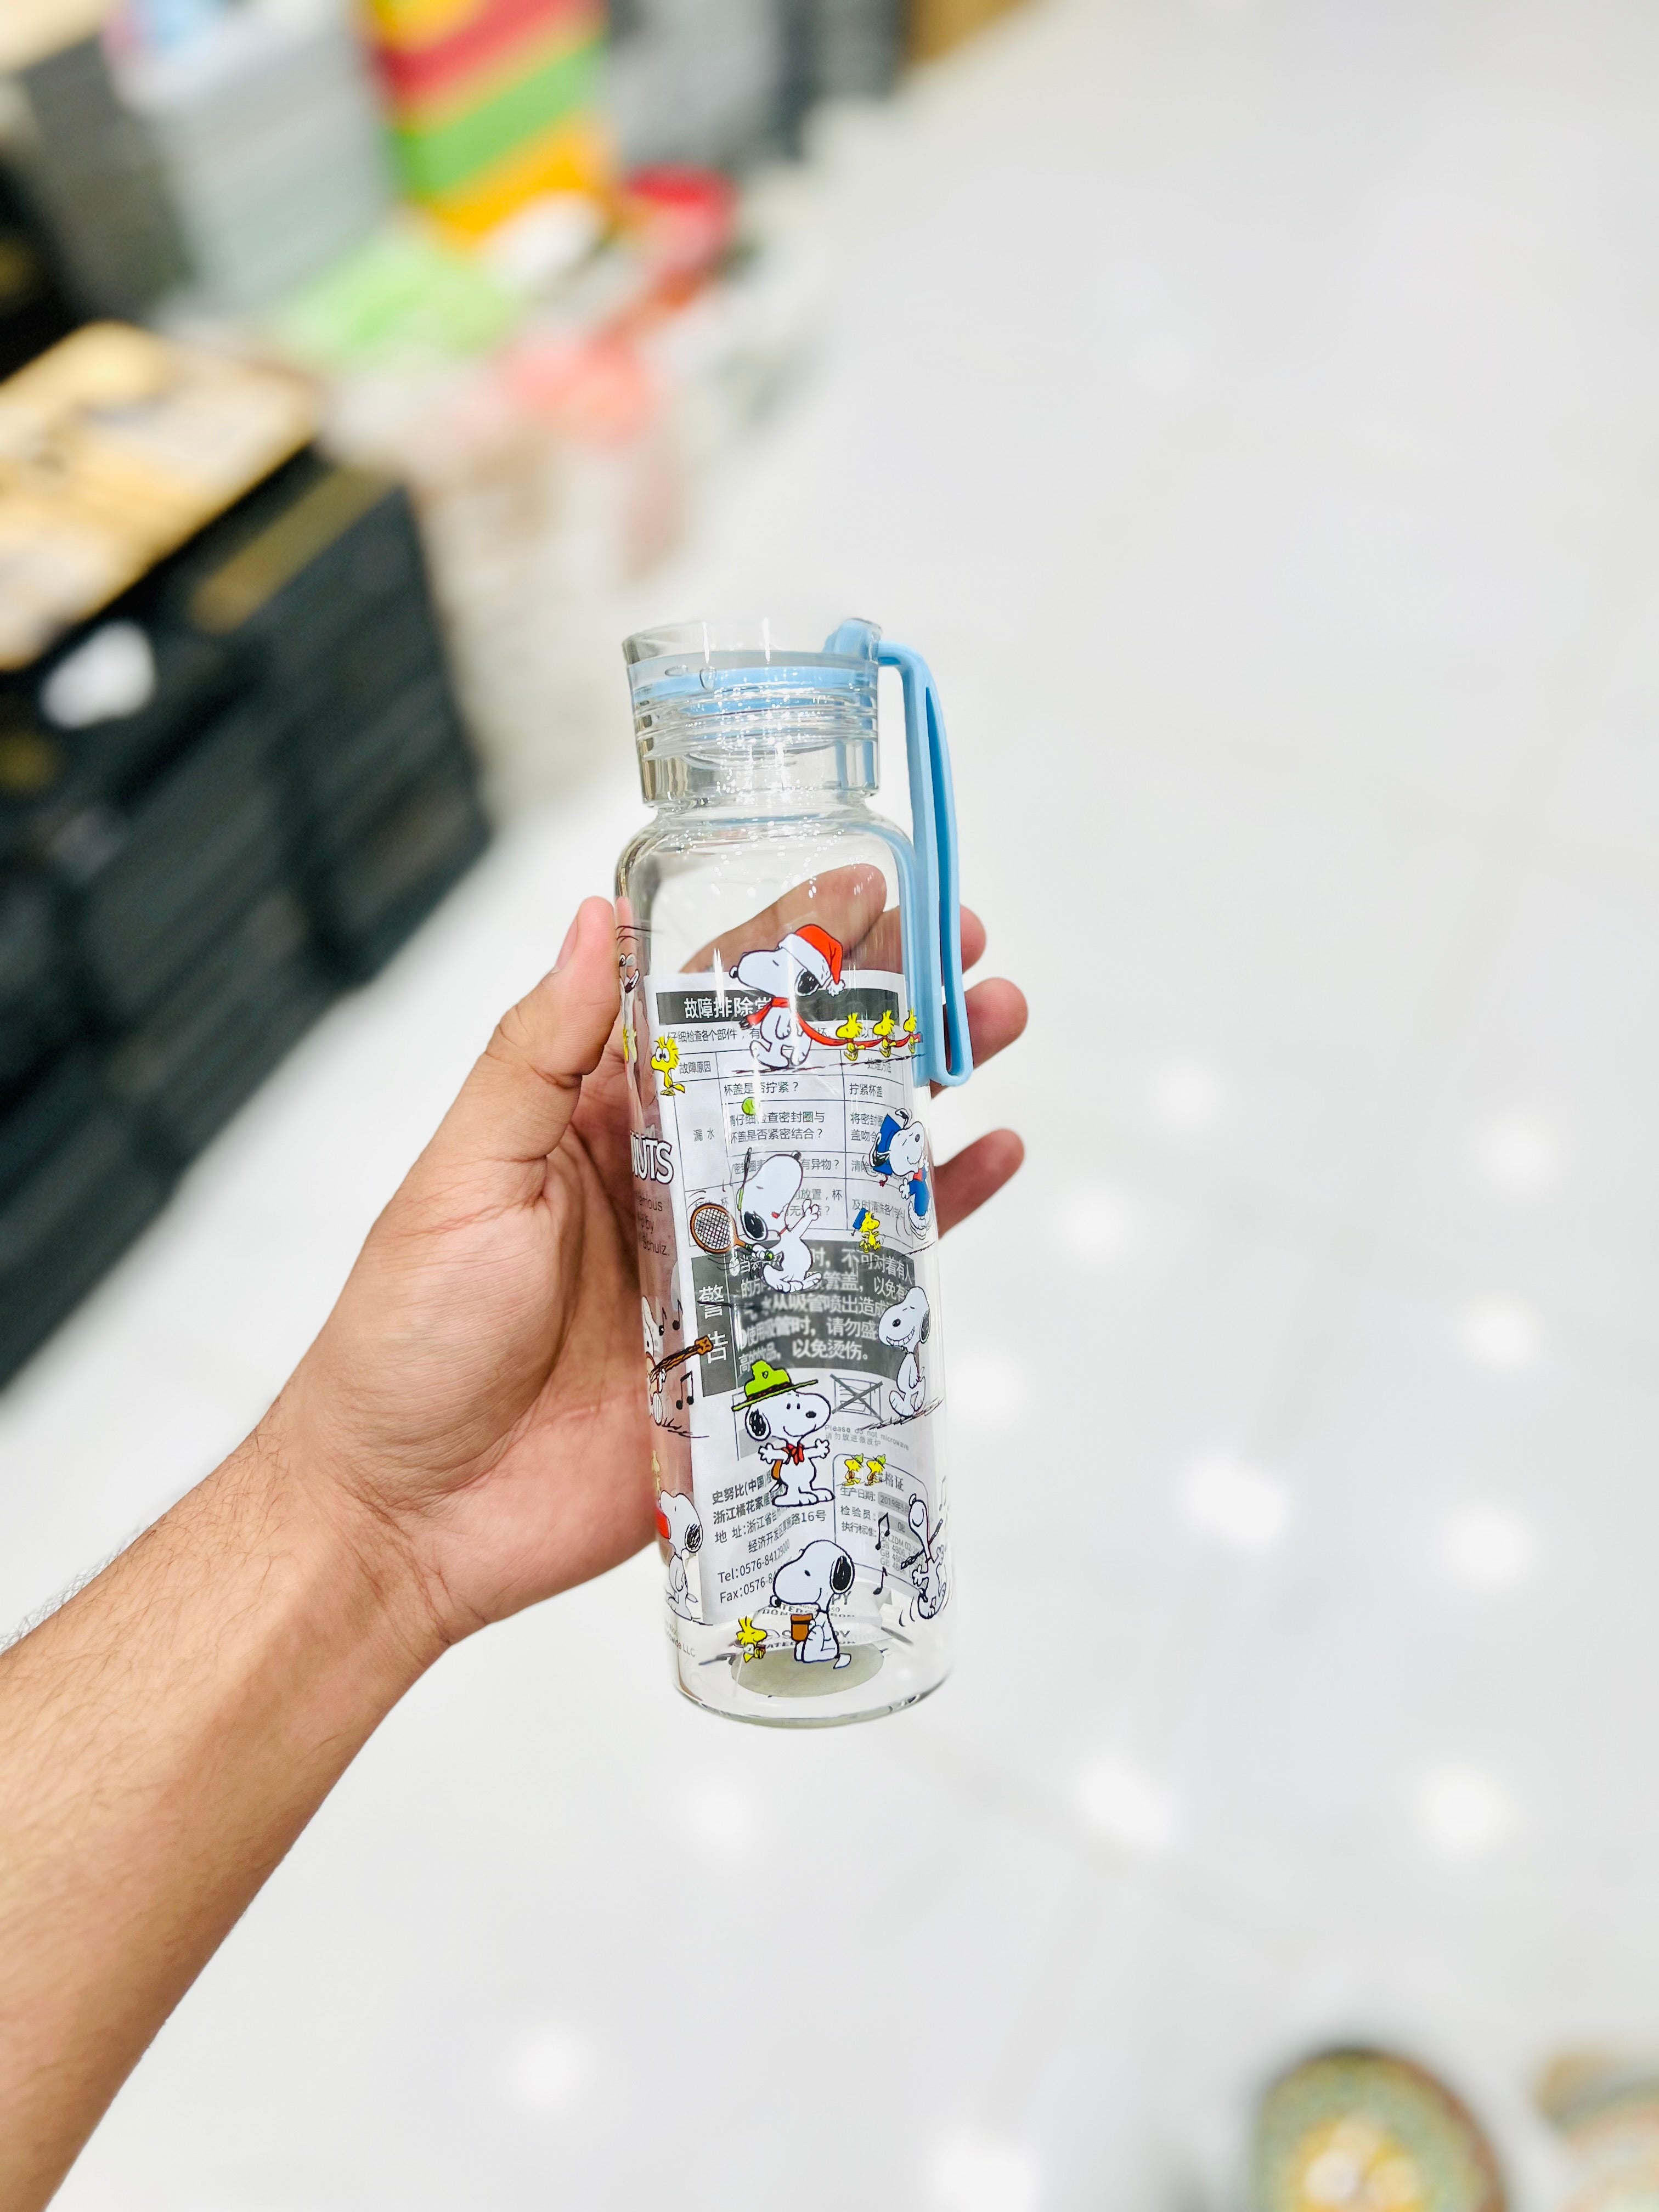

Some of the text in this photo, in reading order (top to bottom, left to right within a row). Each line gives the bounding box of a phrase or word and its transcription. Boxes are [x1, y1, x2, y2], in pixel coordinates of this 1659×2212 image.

[679, 1061, 711, 1074] 故障原因
[849, 1082, 883, 1098] 拧紧杯盖
